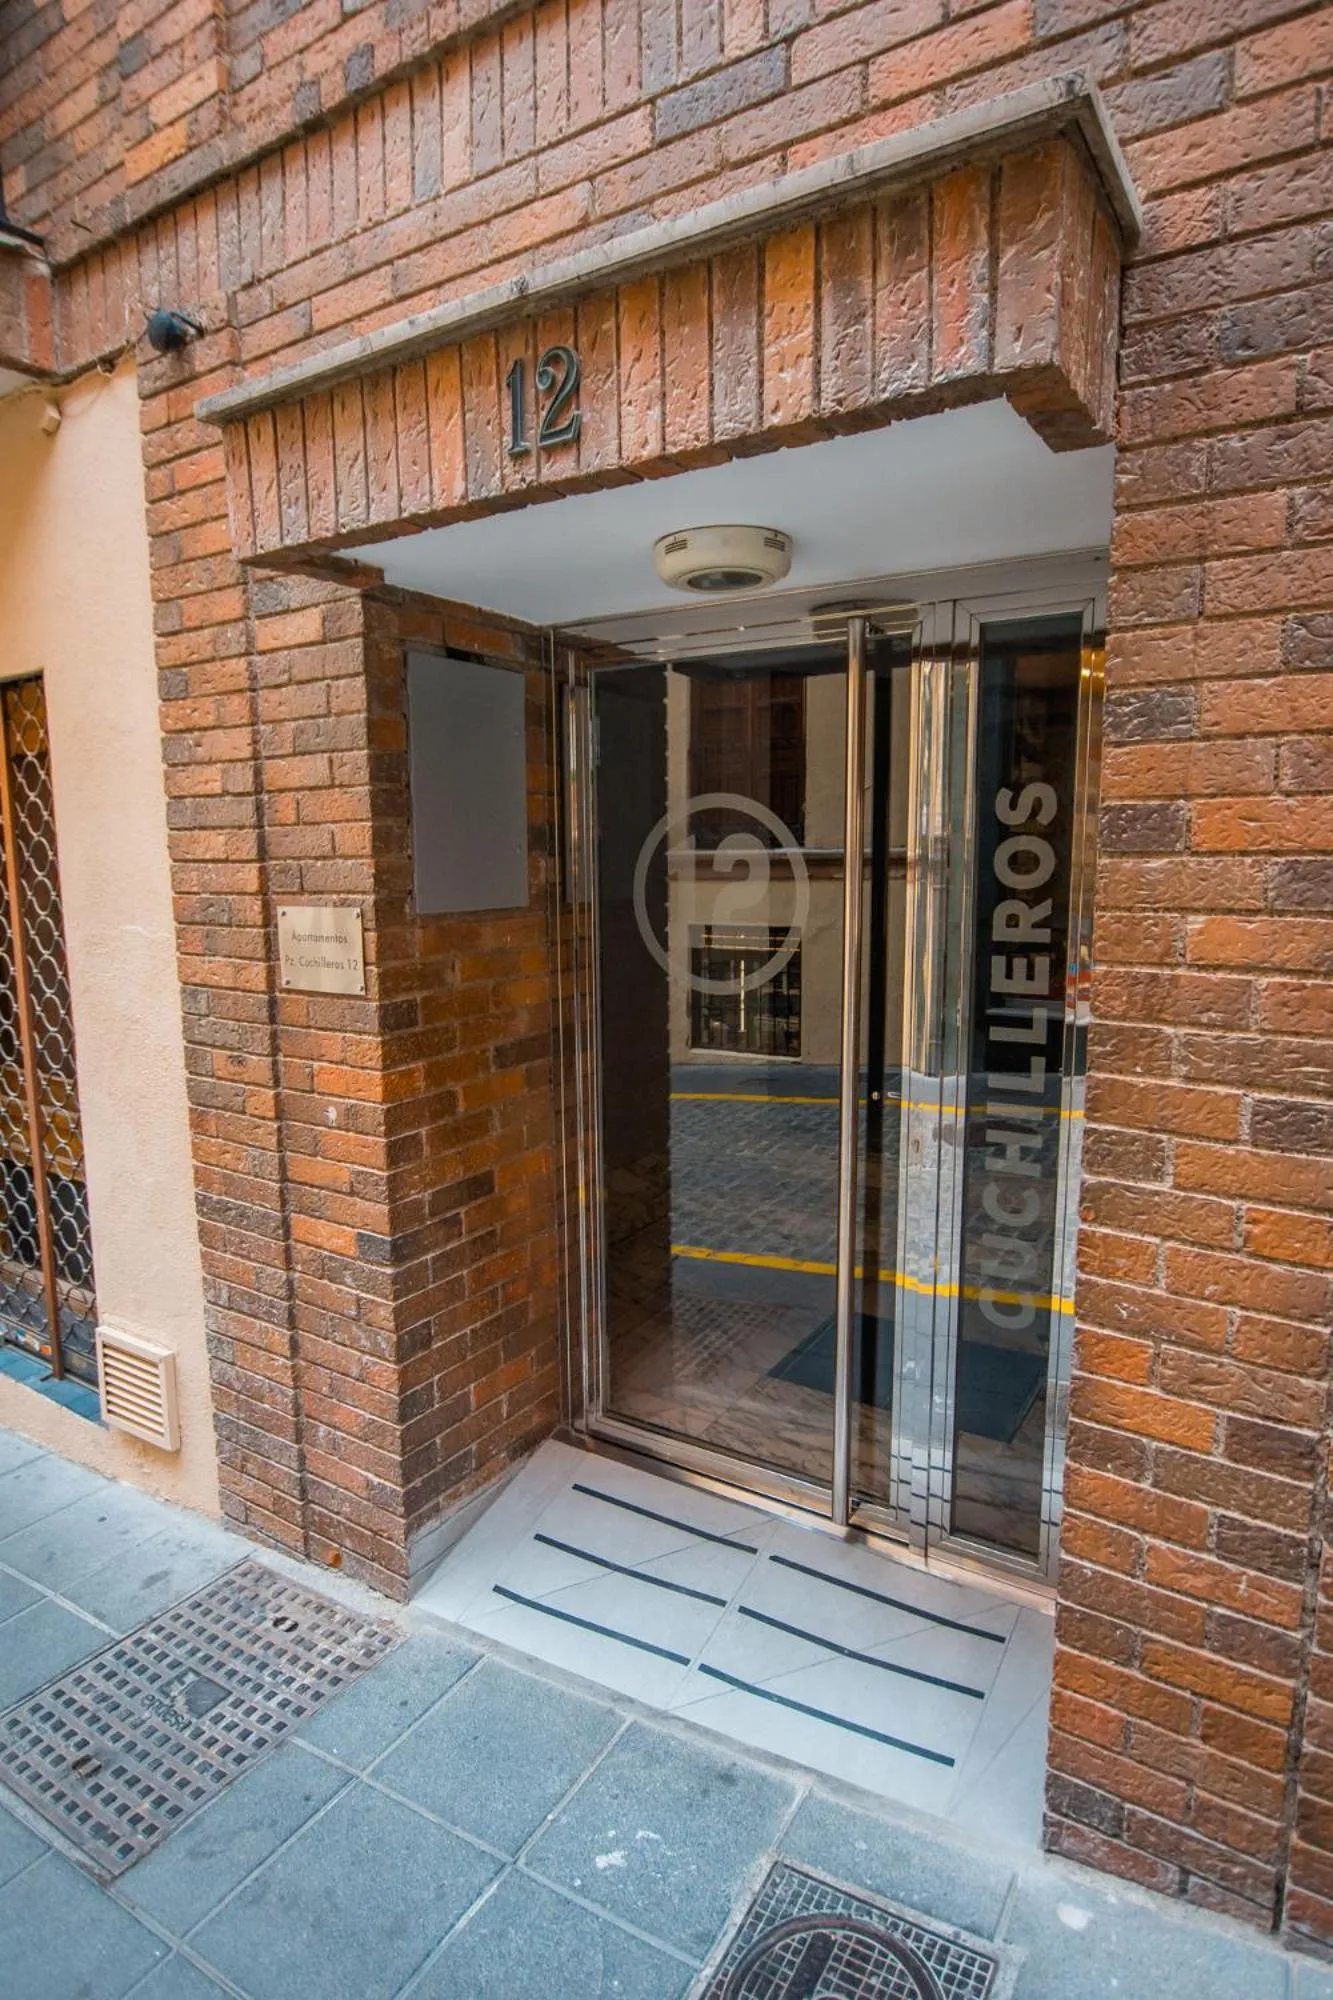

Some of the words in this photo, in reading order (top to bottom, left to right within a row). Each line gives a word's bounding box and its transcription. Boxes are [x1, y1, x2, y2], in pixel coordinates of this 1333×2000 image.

[505, 345, 582, 458] 12
[291, 930, 348, 944] Apartamentos
[667, 832, 771, 949] 12
[299, 956, 344, 969] Cuchilleros
[346, 959, 358, 971] 12
[978, 781, 1058, 1330] CUCHILLEROS
